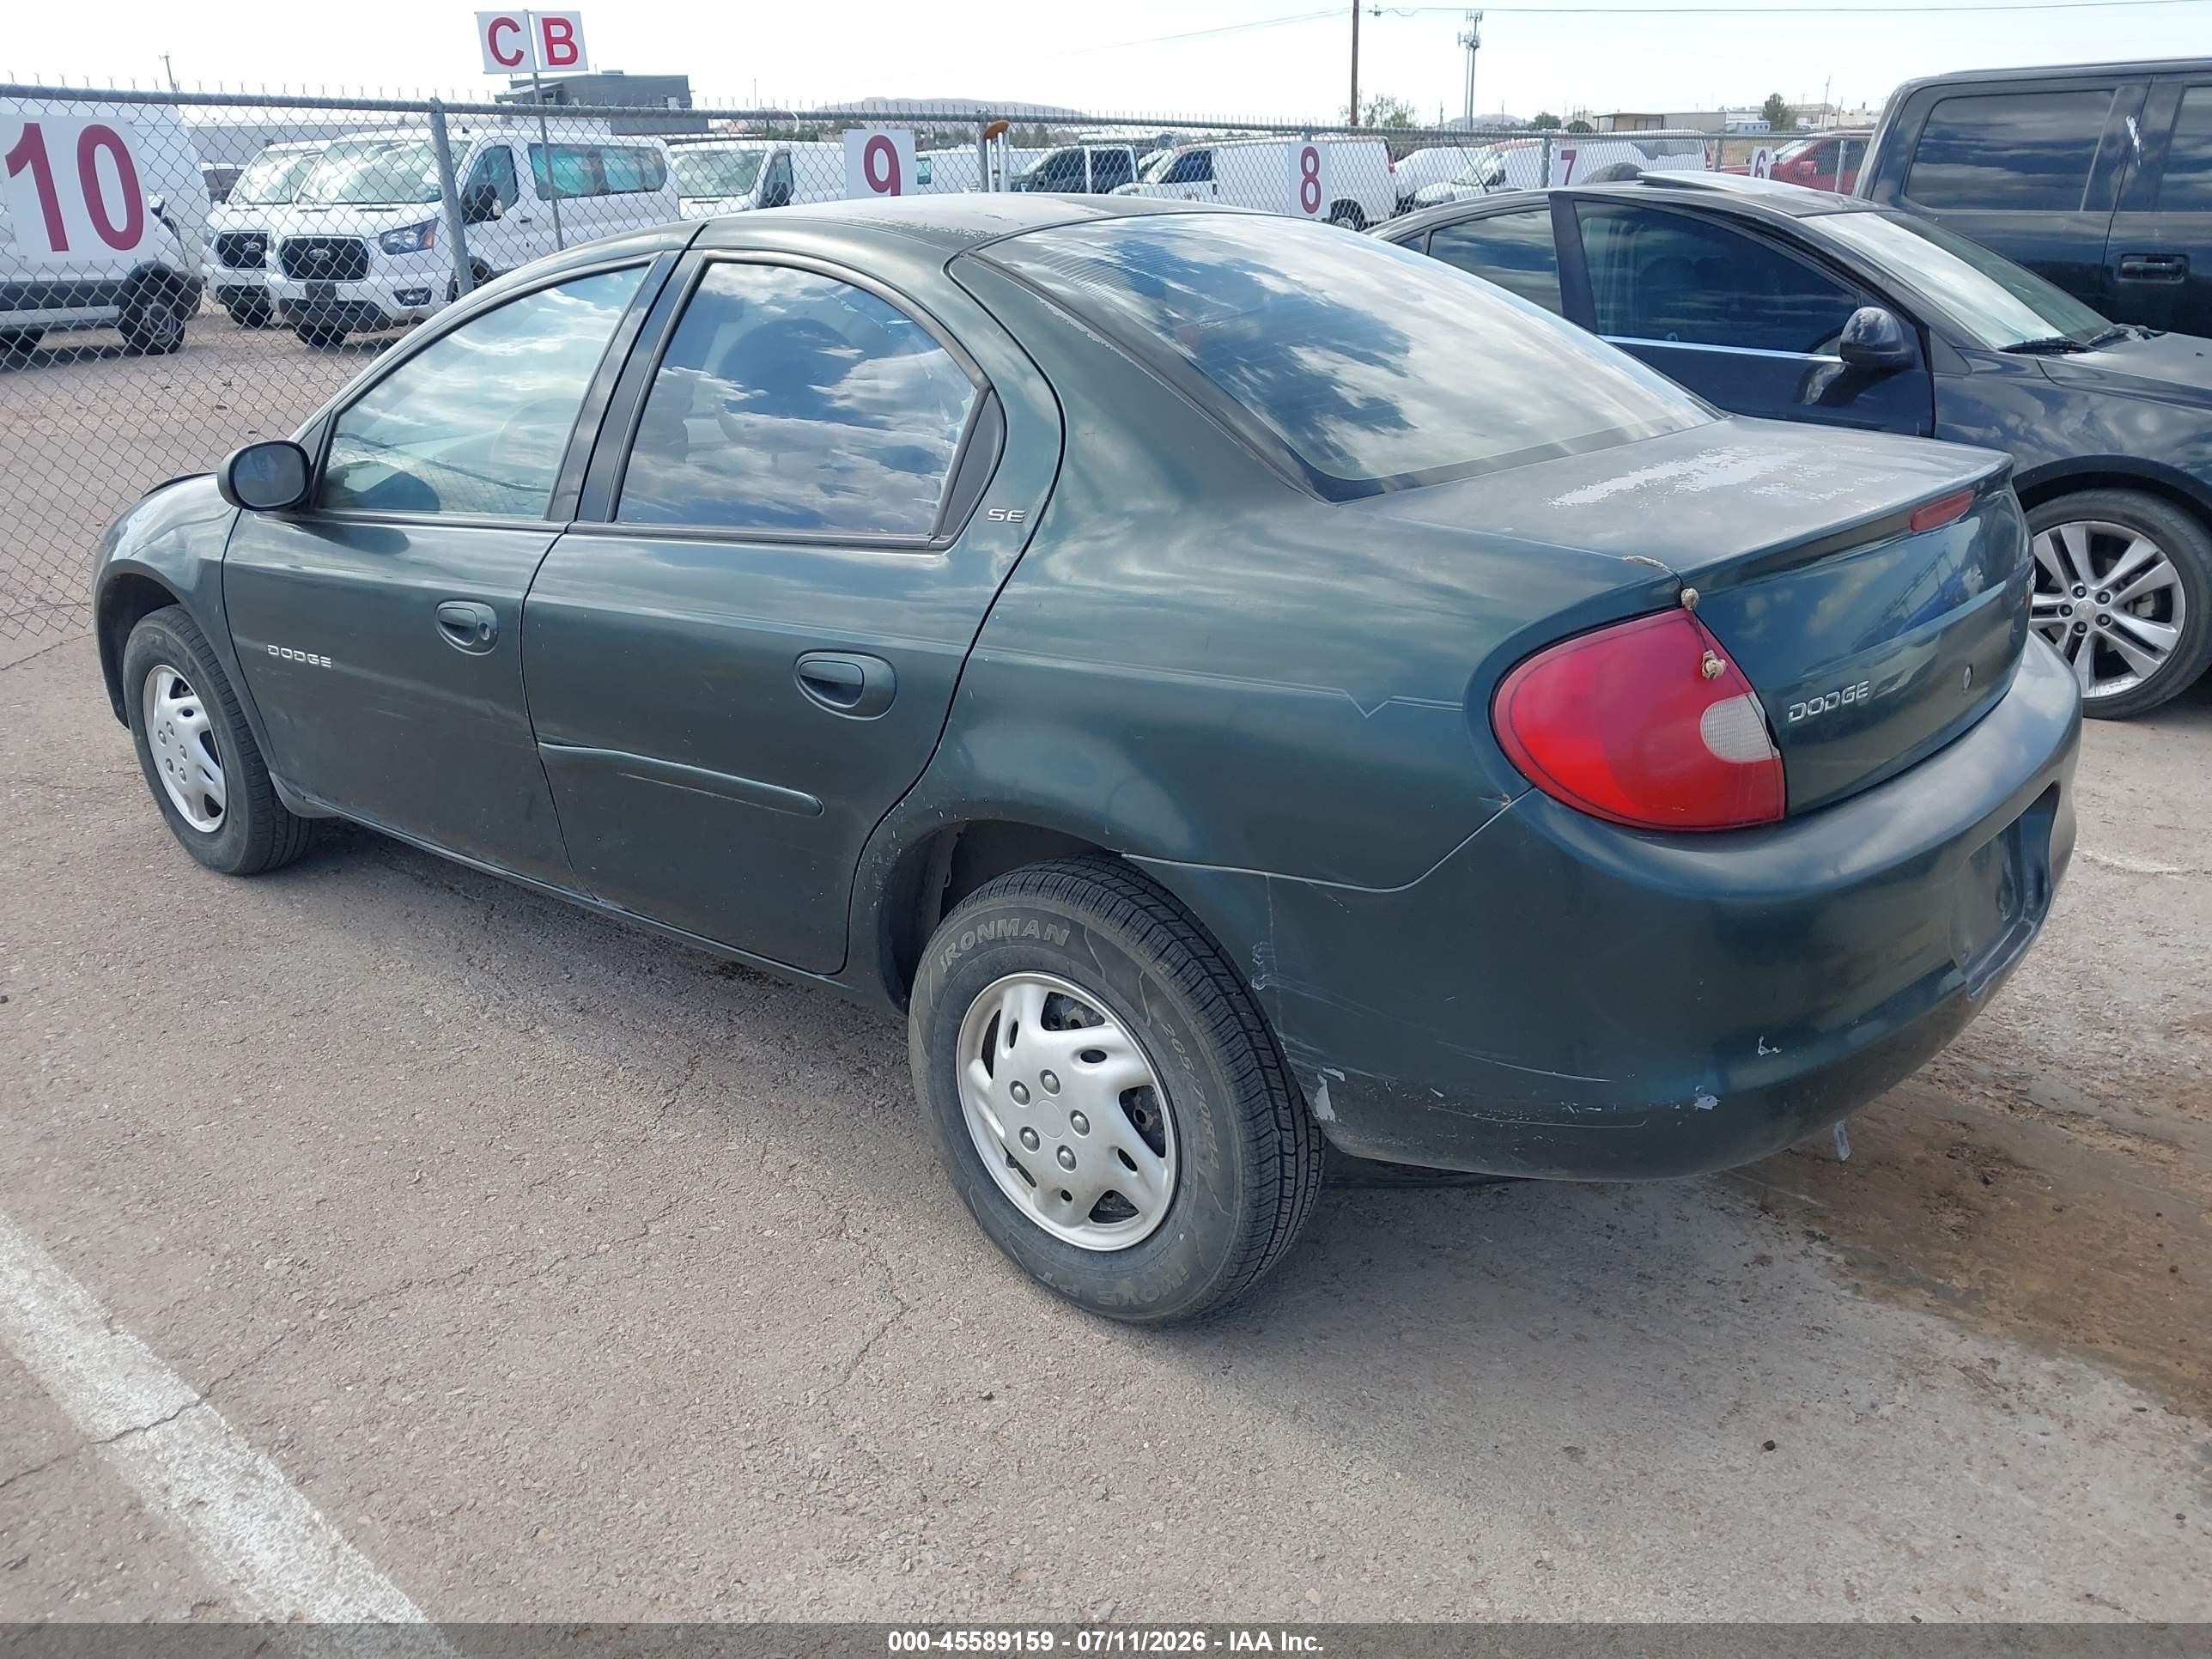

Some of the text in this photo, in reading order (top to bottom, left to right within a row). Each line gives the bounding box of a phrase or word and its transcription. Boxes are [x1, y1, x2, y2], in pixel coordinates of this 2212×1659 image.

[488, 16, 525, 67] C
[541, 17, 578, 66] B
[4, 122, 144, 252] 10
[863, 134, 901, 197] 9
[1300, 146, 1322, 214] 8
[1560, 149, 1577, 186] 7
[1753, 149, 1766, 179] 6
[987, 508, 1026, 523] SE
[267, 644, 332, 669] DODGE
[1788, 680, 1869, 724] DODGE
[939, 918, 1071, 974] IRONMAN
